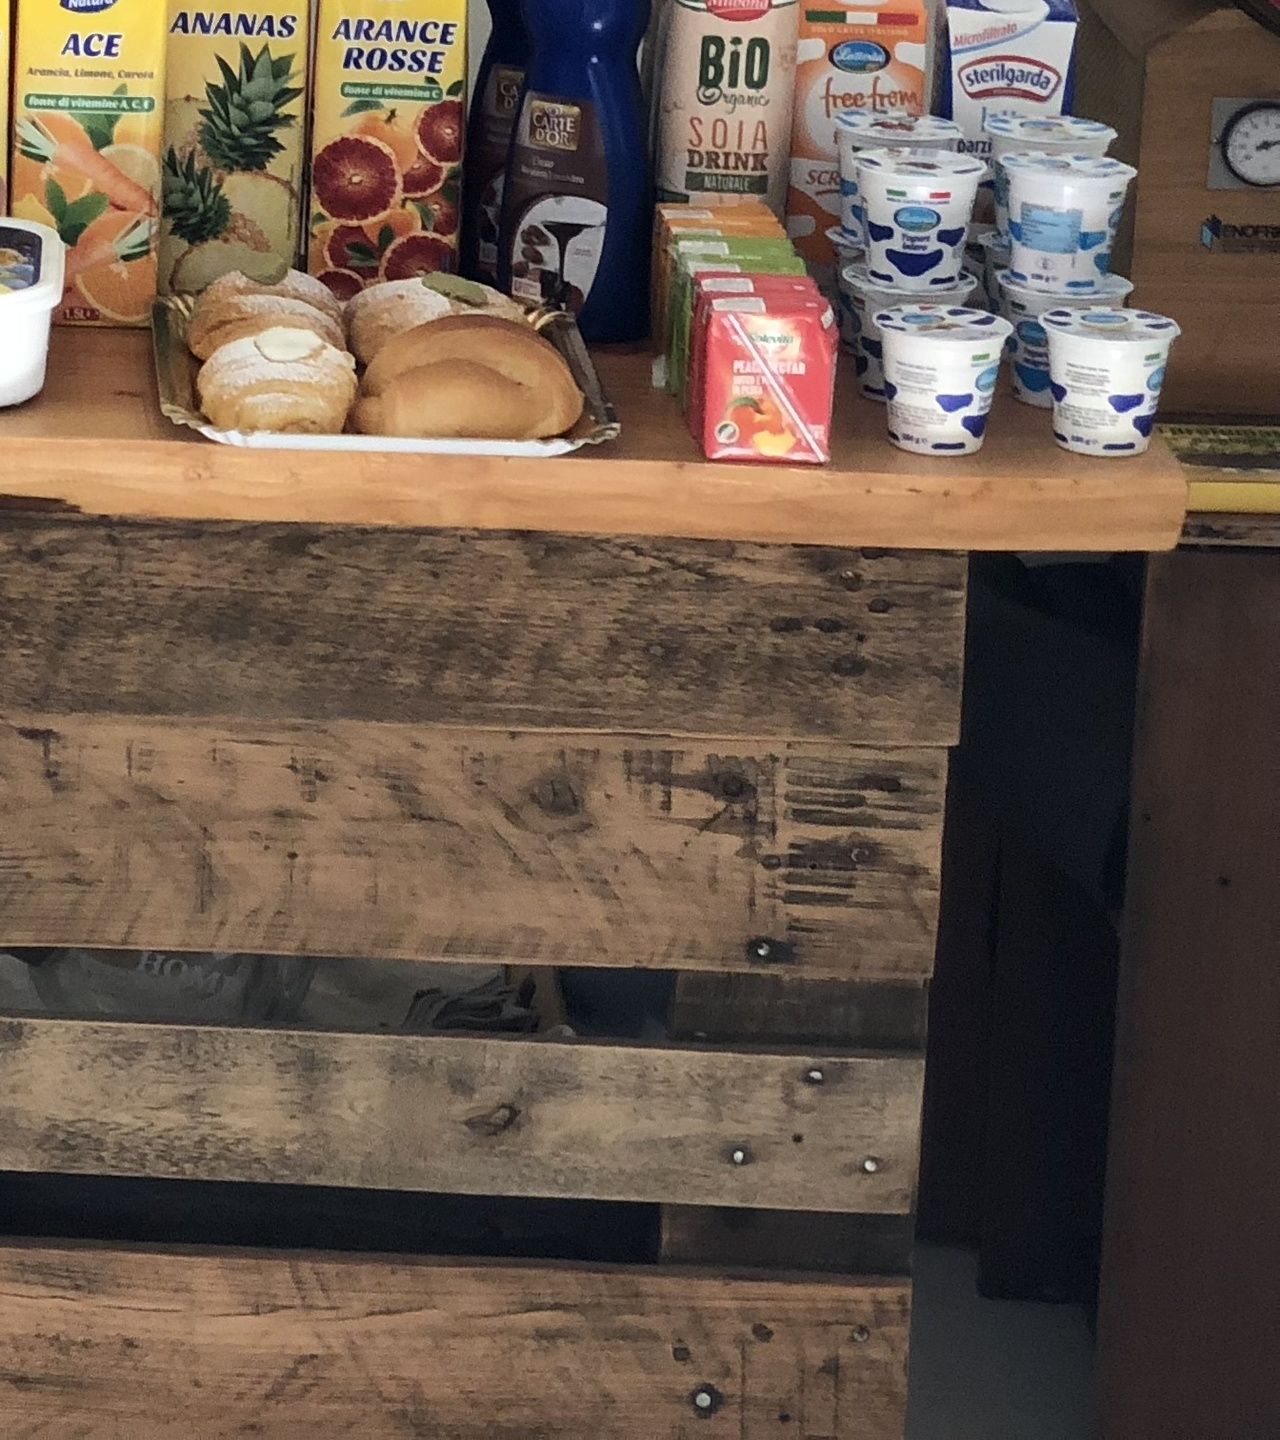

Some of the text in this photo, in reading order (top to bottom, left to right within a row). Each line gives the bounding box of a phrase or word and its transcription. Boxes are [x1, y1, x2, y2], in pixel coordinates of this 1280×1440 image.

[170, 12, 298, 38] ANANAS
[332, 18, 458, 46] ARANCE
[953, 23, 1018, 47] Microfiltrato
[61, 33, 123, 57] ACE
[342, 47, 446, 74] ROSSE
[965, 63, 1051, 90] sterilgarda
[697, 85, 770, 114] Organic
[820, 77, 866, 118] free
[532, 112, 576, 133] CARTE
[689, 117, 768, 150] SOIA
[535, 128, 570, 146] D'OR
[956, 138, 993, 154] parzi
[687, 149, 769, 172] DRINK
[704, 175, 751, 191] NATURALE
